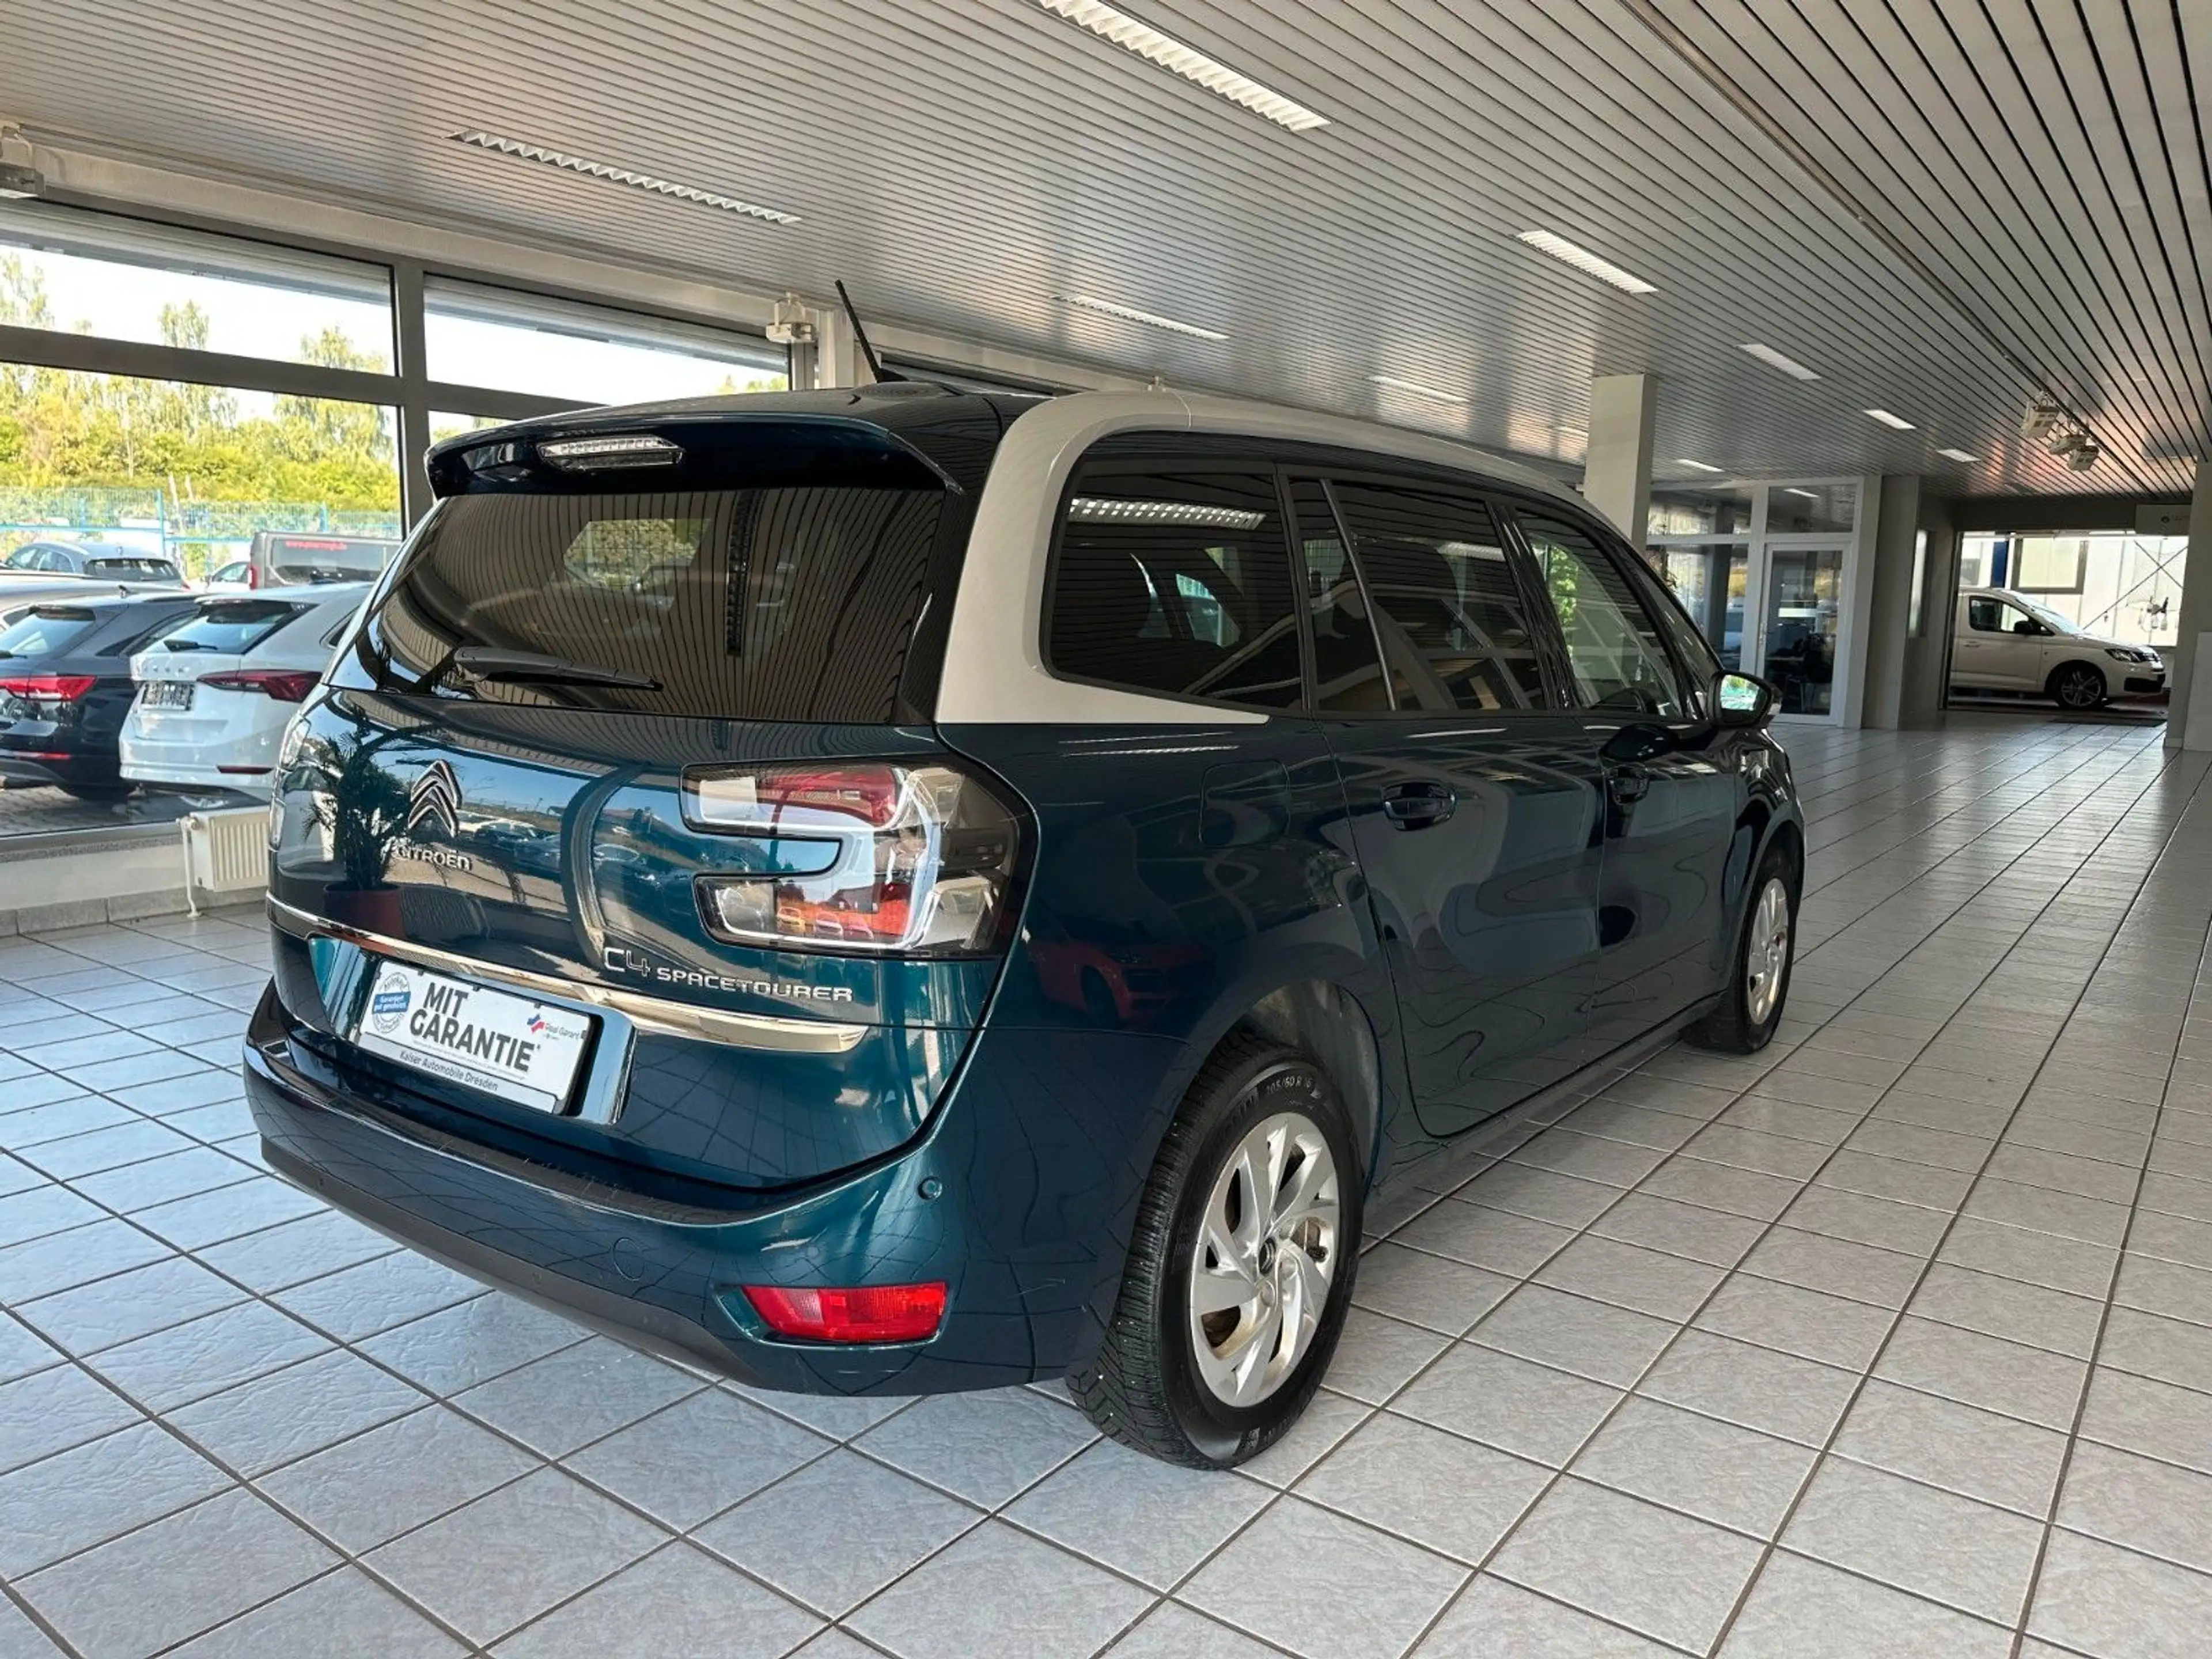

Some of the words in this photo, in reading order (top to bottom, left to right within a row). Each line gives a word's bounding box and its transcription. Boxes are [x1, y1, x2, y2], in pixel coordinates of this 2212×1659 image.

[604, 946, 651, 978] C4
[657, 967, 853, 1002] SPACETOURER
[423, 982, 469, 1018] MIT
[422, 1058, 464, 1080] Automobile
[464, 1071, 498, 1092] Dresden
